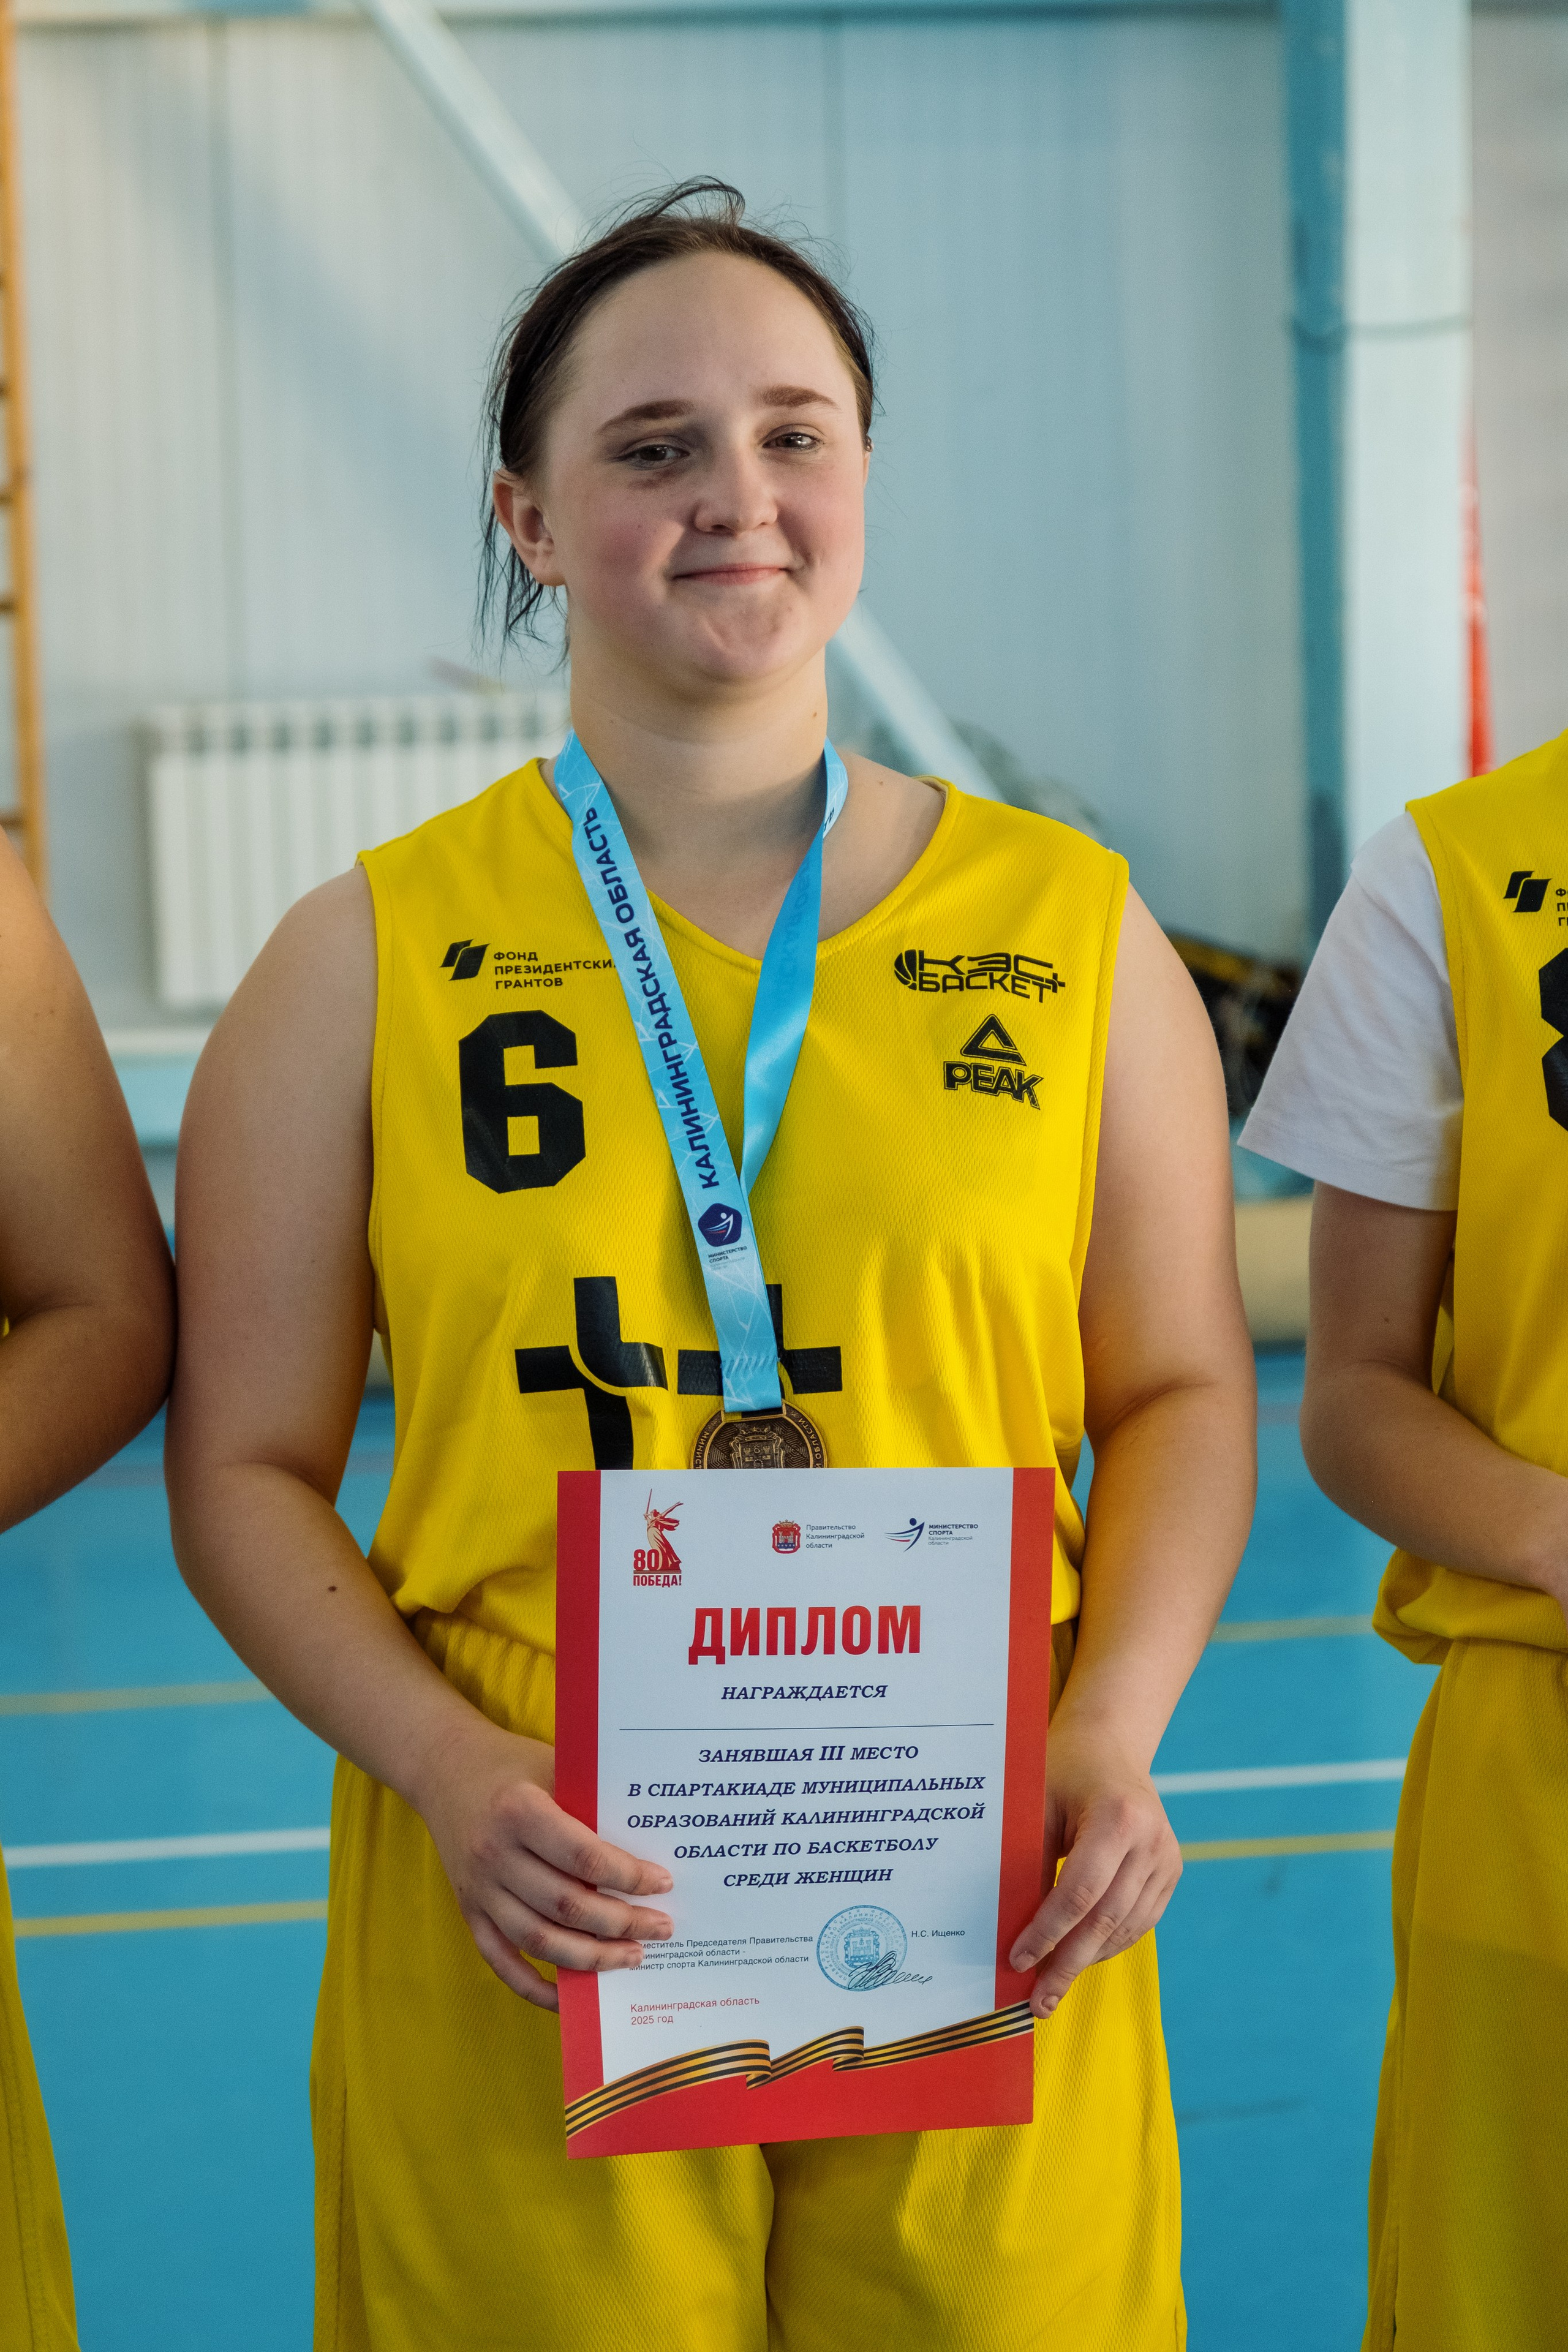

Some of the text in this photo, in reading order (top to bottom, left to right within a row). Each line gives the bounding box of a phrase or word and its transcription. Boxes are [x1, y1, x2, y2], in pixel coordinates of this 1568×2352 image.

[494, 951, 538, 962] ФОНД
[494, 959, 616, 975] ПРЕЗИДЕНТСКИ
[496, 978, 563, 989] ГРАНТОВ
[919, 972, 1052, 1003] БАСКЕТ
[583, 806, 720, 1189] КАЛИНИНГРАДСКАЯ ОБЛАСТЬ
[943, 1061, 1044, 1110] PEAK
[459, 1009, 586, 1194] 6
[799, 1418, 822, 1460] ОБЛАСТИ
[633, 1548, 660, 1570] 80
[633, 1575, 682, 1588] ПОБЕДА!
[688, 1605, 921, 1665] ДИПЛОМ
[721, 1685, 888, 1702] НАГРАЖДАЕТСЯ
[698, 1746, 919, 1763] ЗАНЯВШАЯ III МЕСТО
[627, 1776, 986, 1798] В СПАРТАКИАДЕ МУНИЦИПАЛЬНЫХ
[627, 1802, 986, 1828] ОБРАЗОВАНИЙ КАЛИНИНГРАДСКОЙ
[674, 1838, 939, 1858] ОБЛАСТИ ПО БАСКЕТБОЛУ
[723, 1869, 894, 1888] СРЕДИ ЖЕНЩИН
[687, 1938, 747, 1948] Председателя
[749, 1936, 813, 1946] Правительства
[932, 1929, 965, 1938] Ищенко
[644, 1950, 703, 1960] ининградской
[698, 1957, 772, 1967] Калининградской
[630, 1997, 760, 2013] Калининградская область
[631, 2016, 674, 2025] 2025 год
